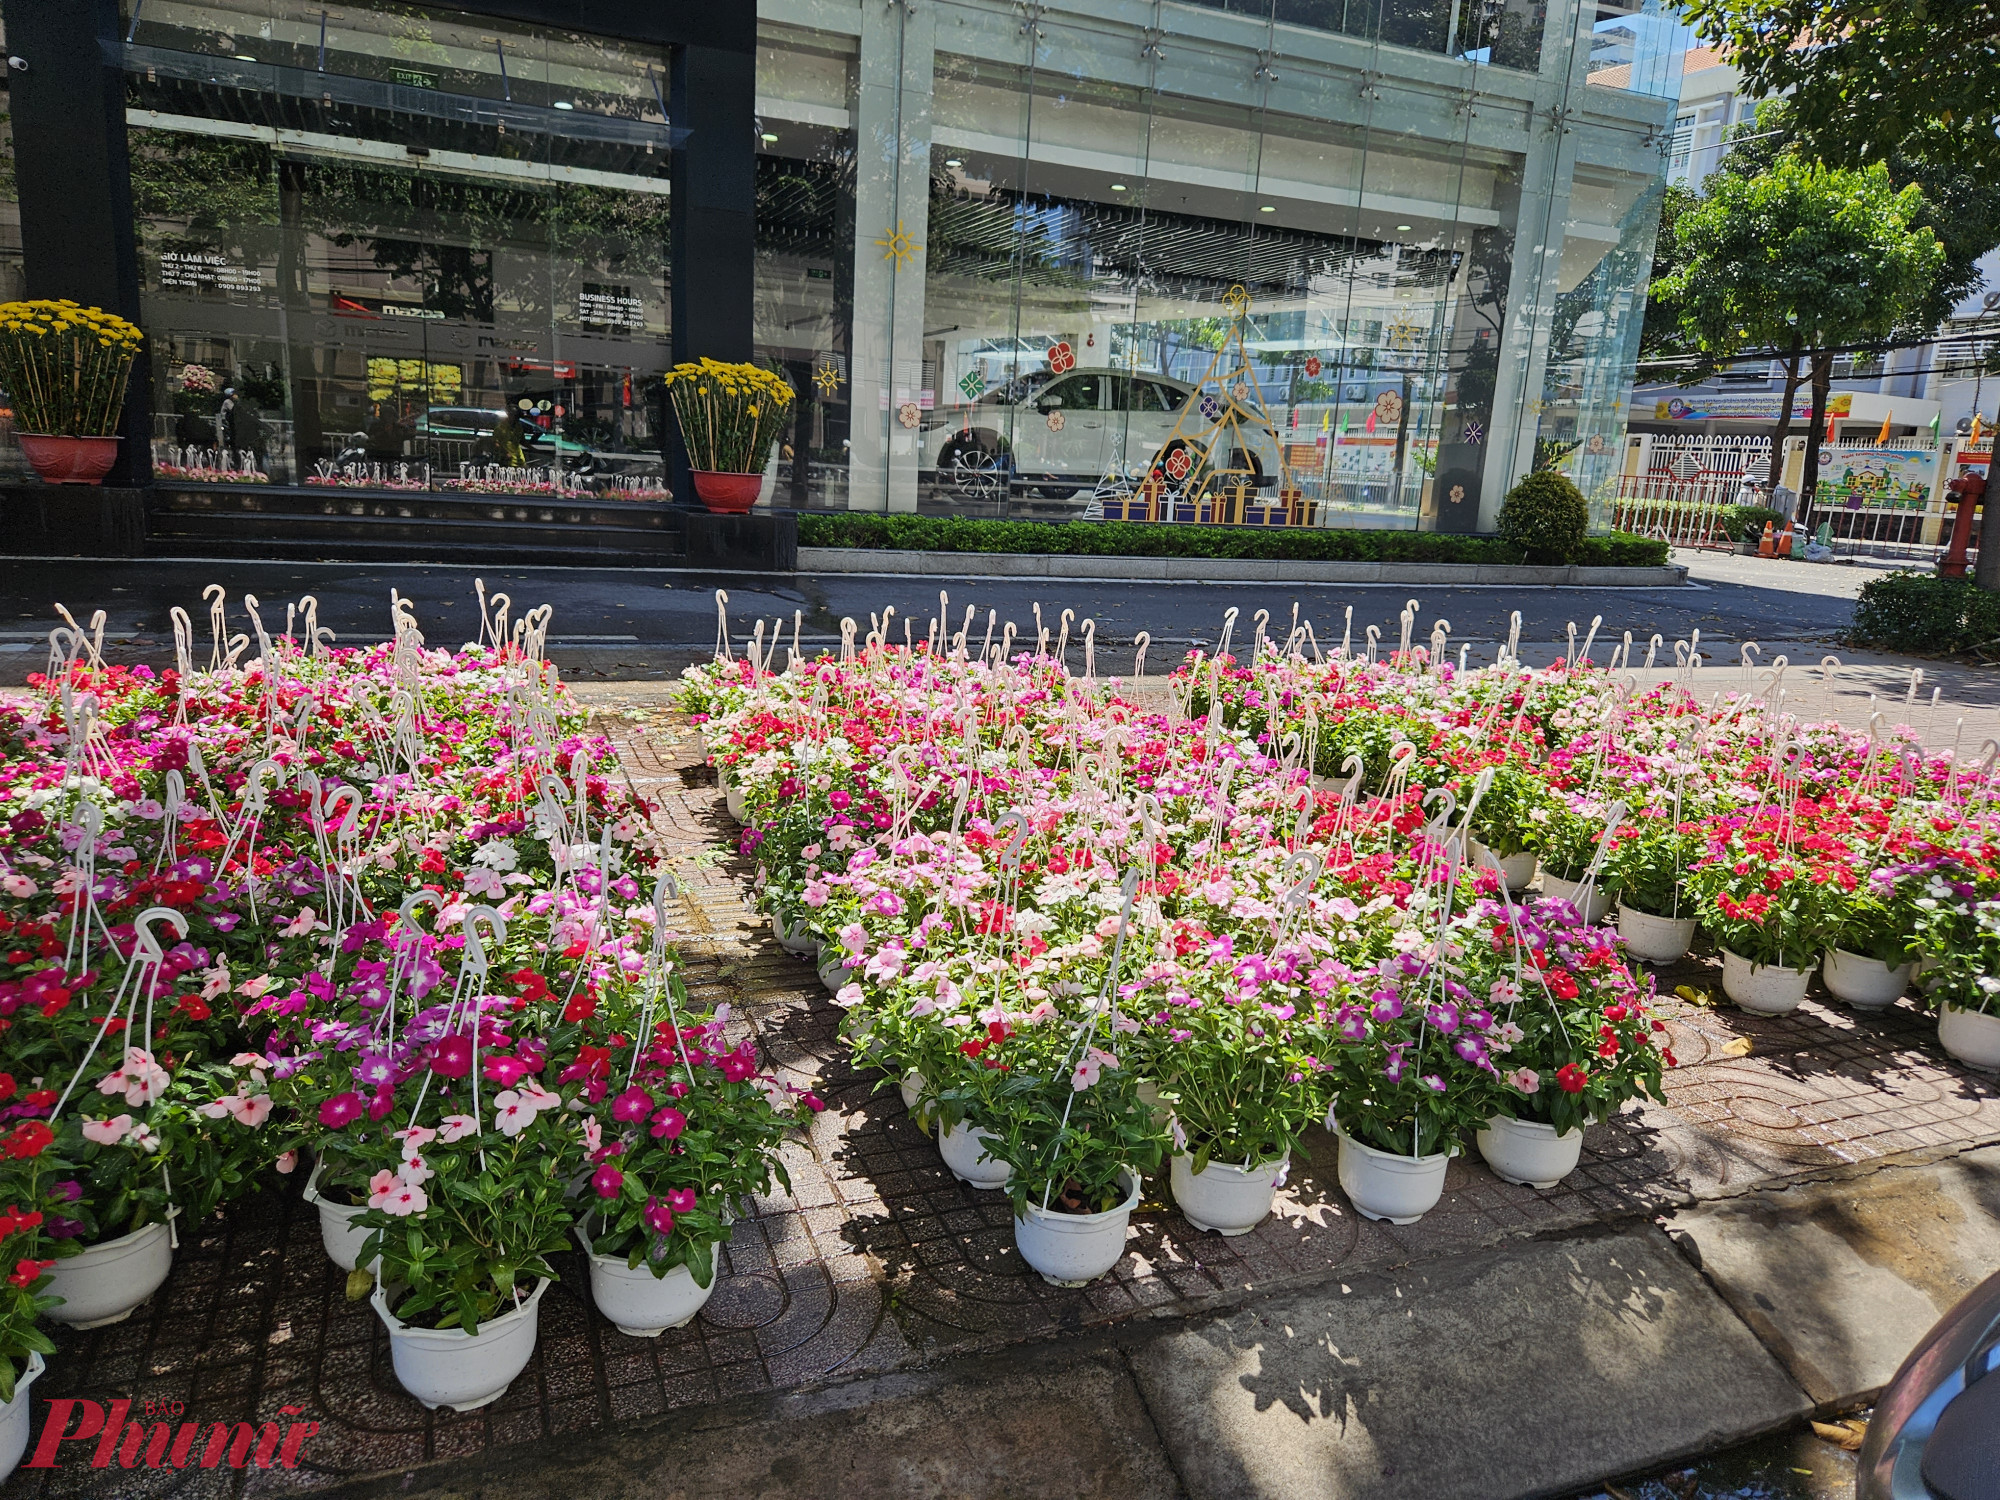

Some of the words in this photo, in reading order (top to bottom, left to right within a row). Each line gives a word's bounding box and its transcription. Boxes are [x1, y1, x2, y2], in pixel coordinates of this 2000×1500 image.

[160, 251, 178, 261] GIỜ
[181, 253, 202, 263] LÀM
[204, 255, 226, 266] VIỆC
[579, 293, 615, 303] BUSINESS
[617, 297, 642, 307] HOURS
